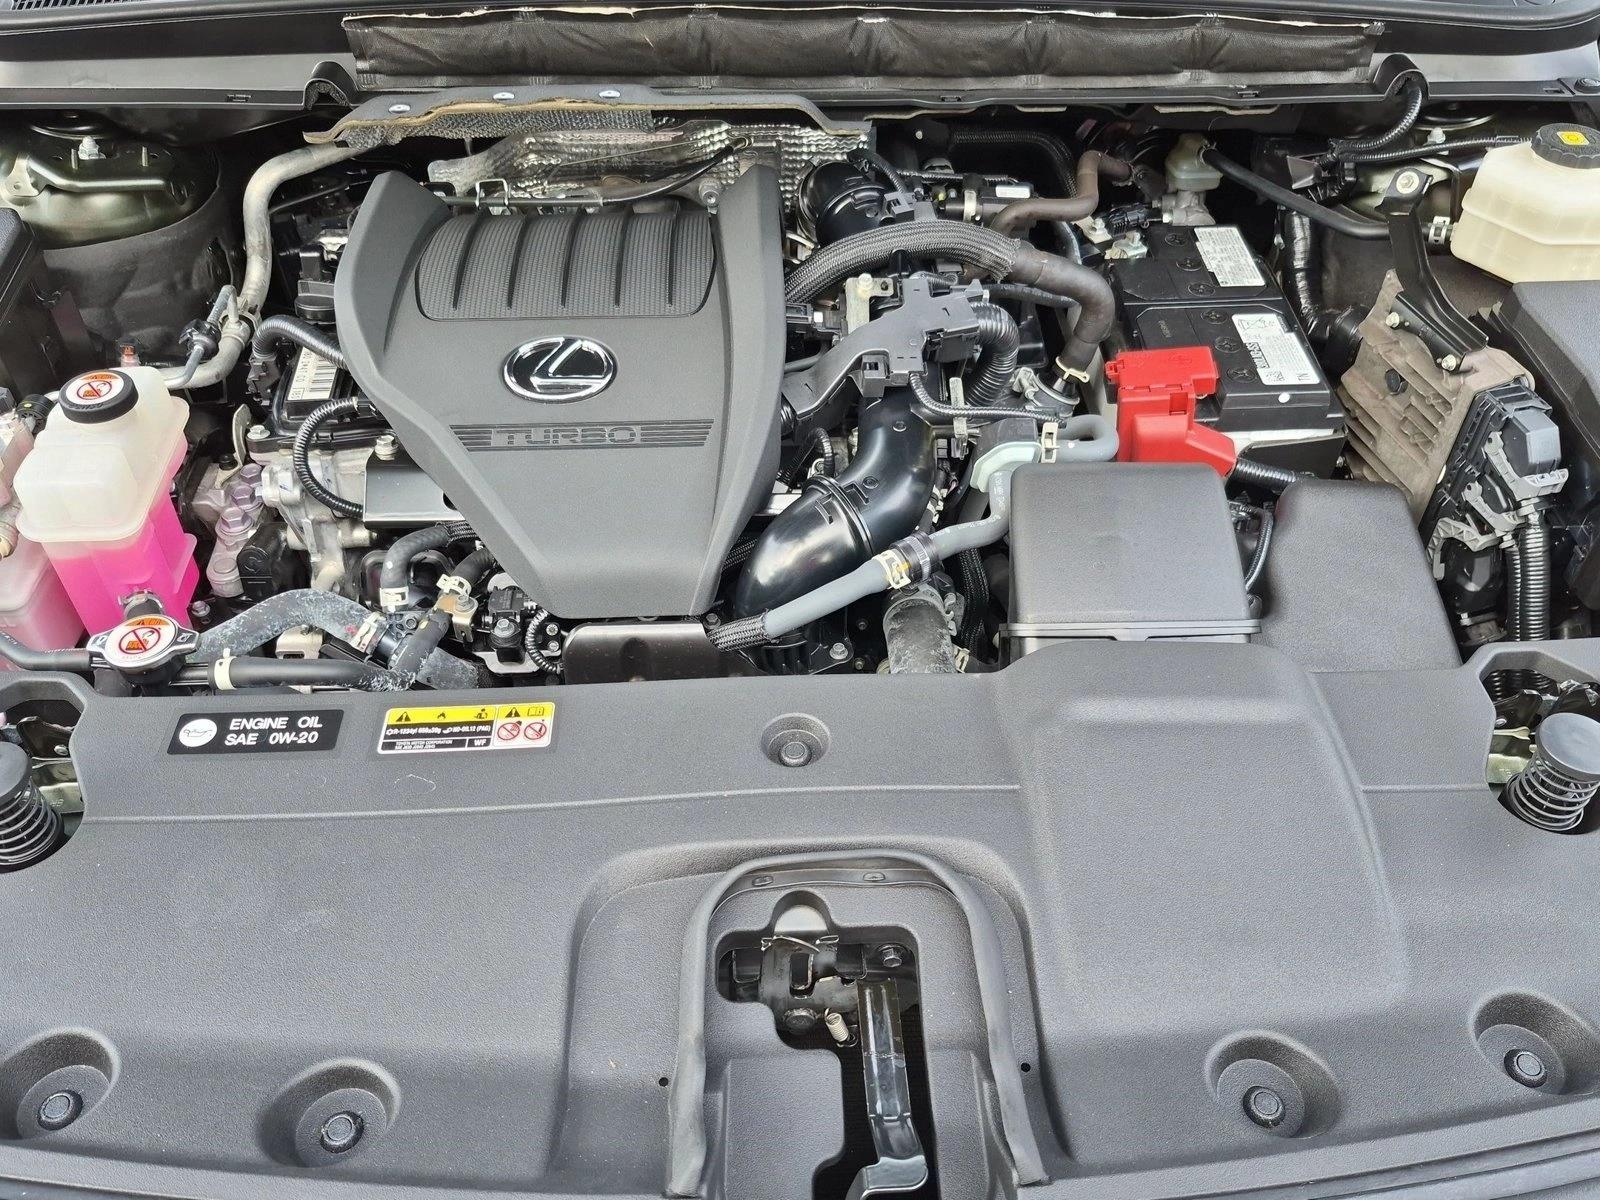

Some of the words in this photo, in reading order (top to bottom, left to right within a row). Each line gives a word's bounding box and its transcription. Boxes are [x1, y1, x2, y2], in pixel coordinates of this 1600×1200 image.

[496, 426, 637, 446] TURBO
[229, 716, 289, 731] ENGINE
[297, 716, 323, 729] OIL
[224, 733, 259, 747] SAE
[268, 731, 319, 745] 0W-20
[473, 738, 487, 747] WF
